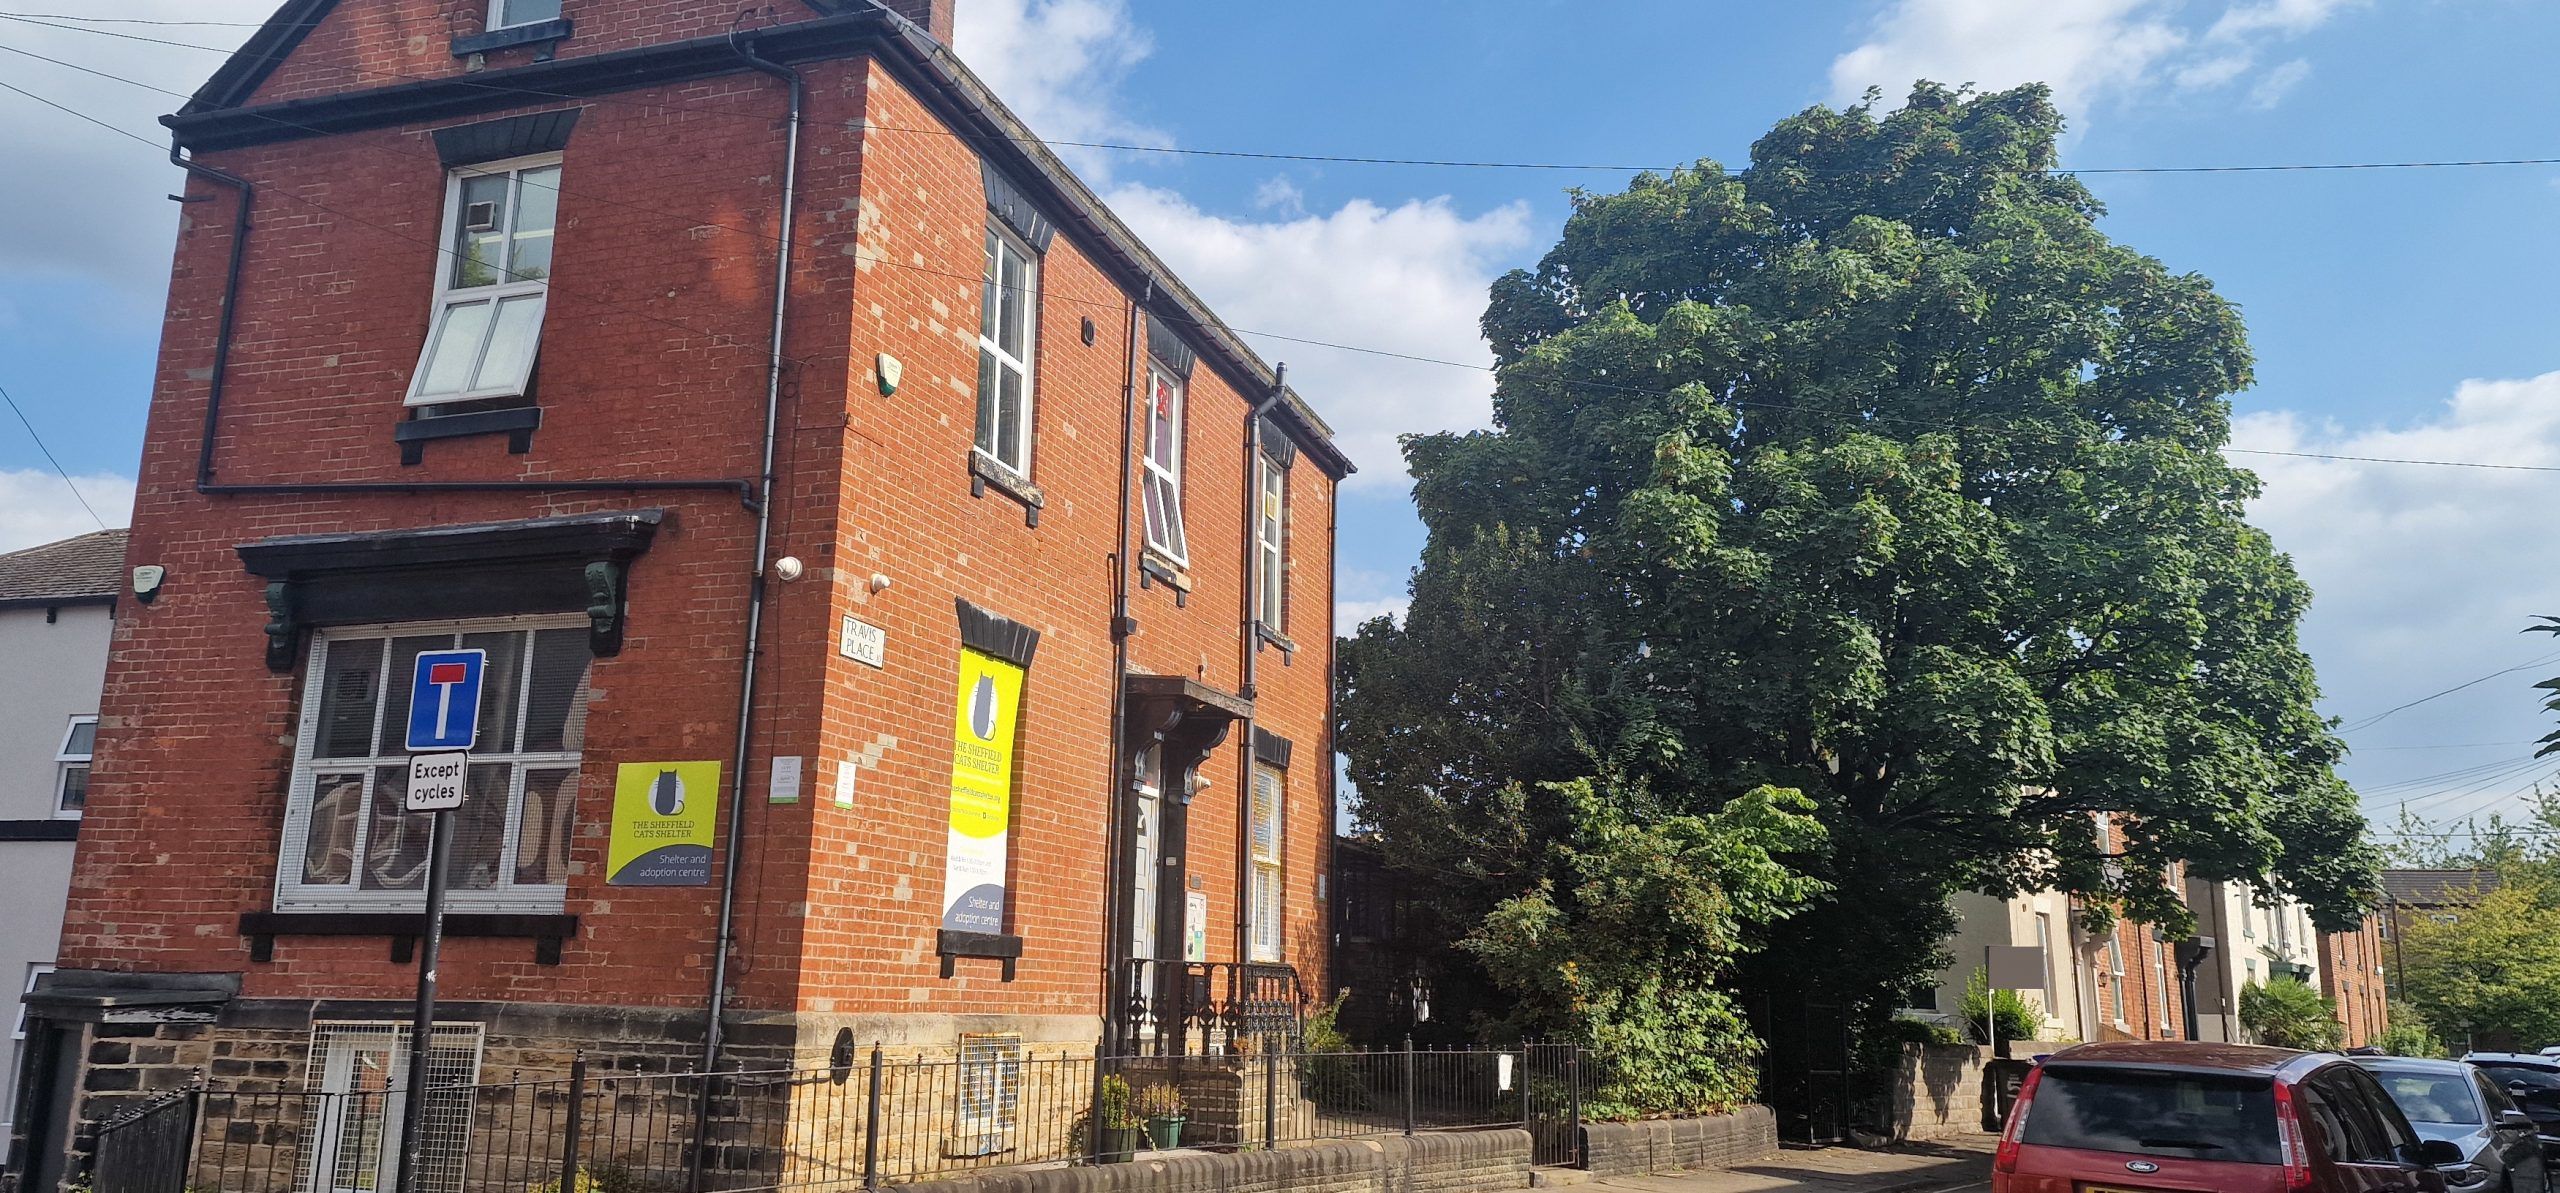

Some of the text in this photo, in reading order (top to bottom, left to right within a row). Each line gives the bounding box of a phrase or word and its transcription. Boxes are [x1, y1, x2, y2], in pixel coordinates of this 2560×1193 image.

[845, 619, 877, 642] TRAVIS
[846, 638, 874, 660] PLACE
[954, 740, 1003, 762] THE SHEFFIELD
[415, 761, 459, 780] Except
[954, 753, 1000, 775] CATS SHELTER
[415, 783, 455, 803] cycles
[632, 820, 695, 829] THE SHEFFIELD
[633, 829, 692, 838] CATS SHELTER
[660, 854, 707, 864] Shelter and
[640, 868, 705, 879] adoption centre
[968, 896, 1000, 910] Shelter and
[954, 912, 999, 926] adoption centre
